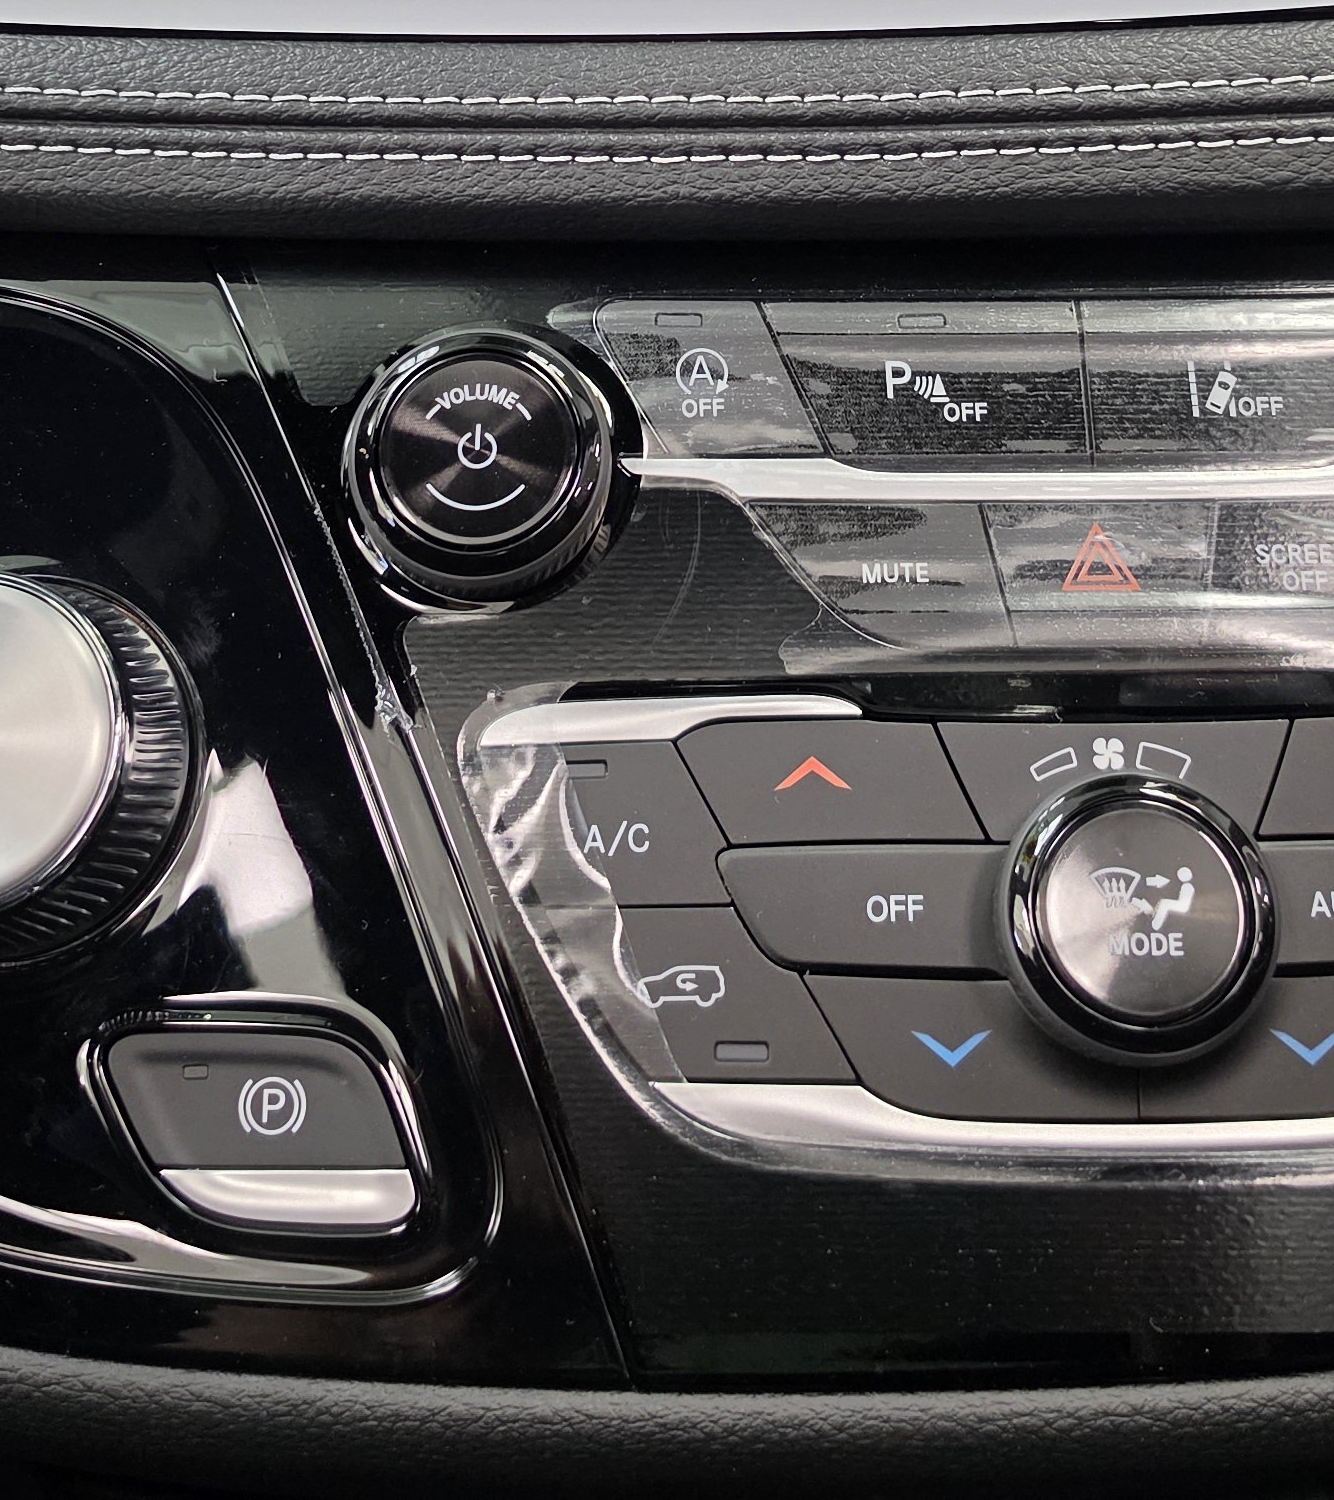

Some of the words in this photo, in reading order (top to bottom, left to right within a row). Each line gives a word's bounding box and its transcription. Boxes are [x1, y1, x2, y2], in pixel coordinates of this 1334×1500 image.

[434, 383, 520, 411] VOLUME
[681, 399, 725, 419] OFF
[1238, 396, 1284, 417] OFF
[943, 402, 988, 423] OFF
[862, 562, 930, 586] MUTE
[1282, 570, 1328, 592] OFF
[582, 821, 651, 858] A/C
[866, 894, 925, 924] OFF
[1108, 931, 1185, 958] MODE
